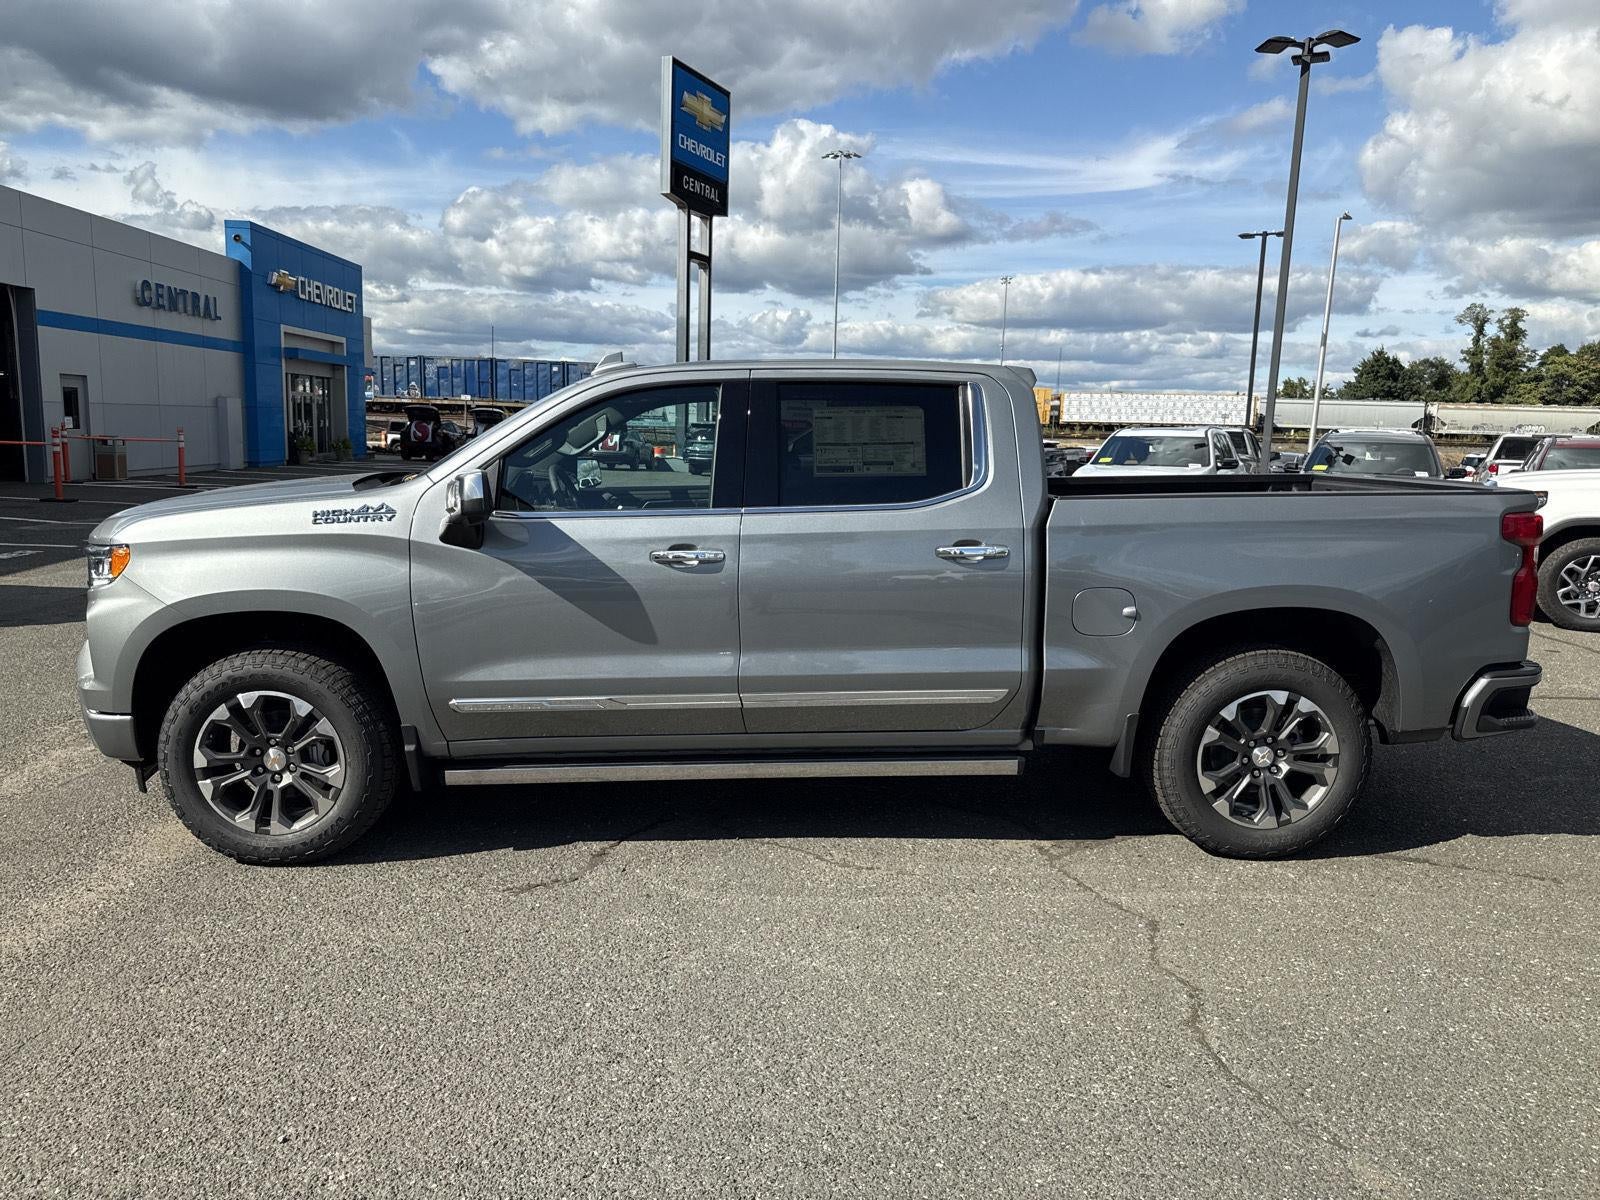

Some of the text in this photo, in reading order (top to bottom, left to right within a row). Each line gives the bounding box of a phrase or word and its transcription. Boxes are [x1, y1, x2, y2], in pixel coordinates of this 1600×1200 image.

[678, 133, 726, 168] CHEVROLET
[682, 175, 720, 203] CENTRAL
[136, 279, 222, 321] CENTRAL
[297, 276, 358, 313] CHEVROLET
[312, 508, 355, 518] HIGH
[312, 514, 396, 525] COUNTRY
